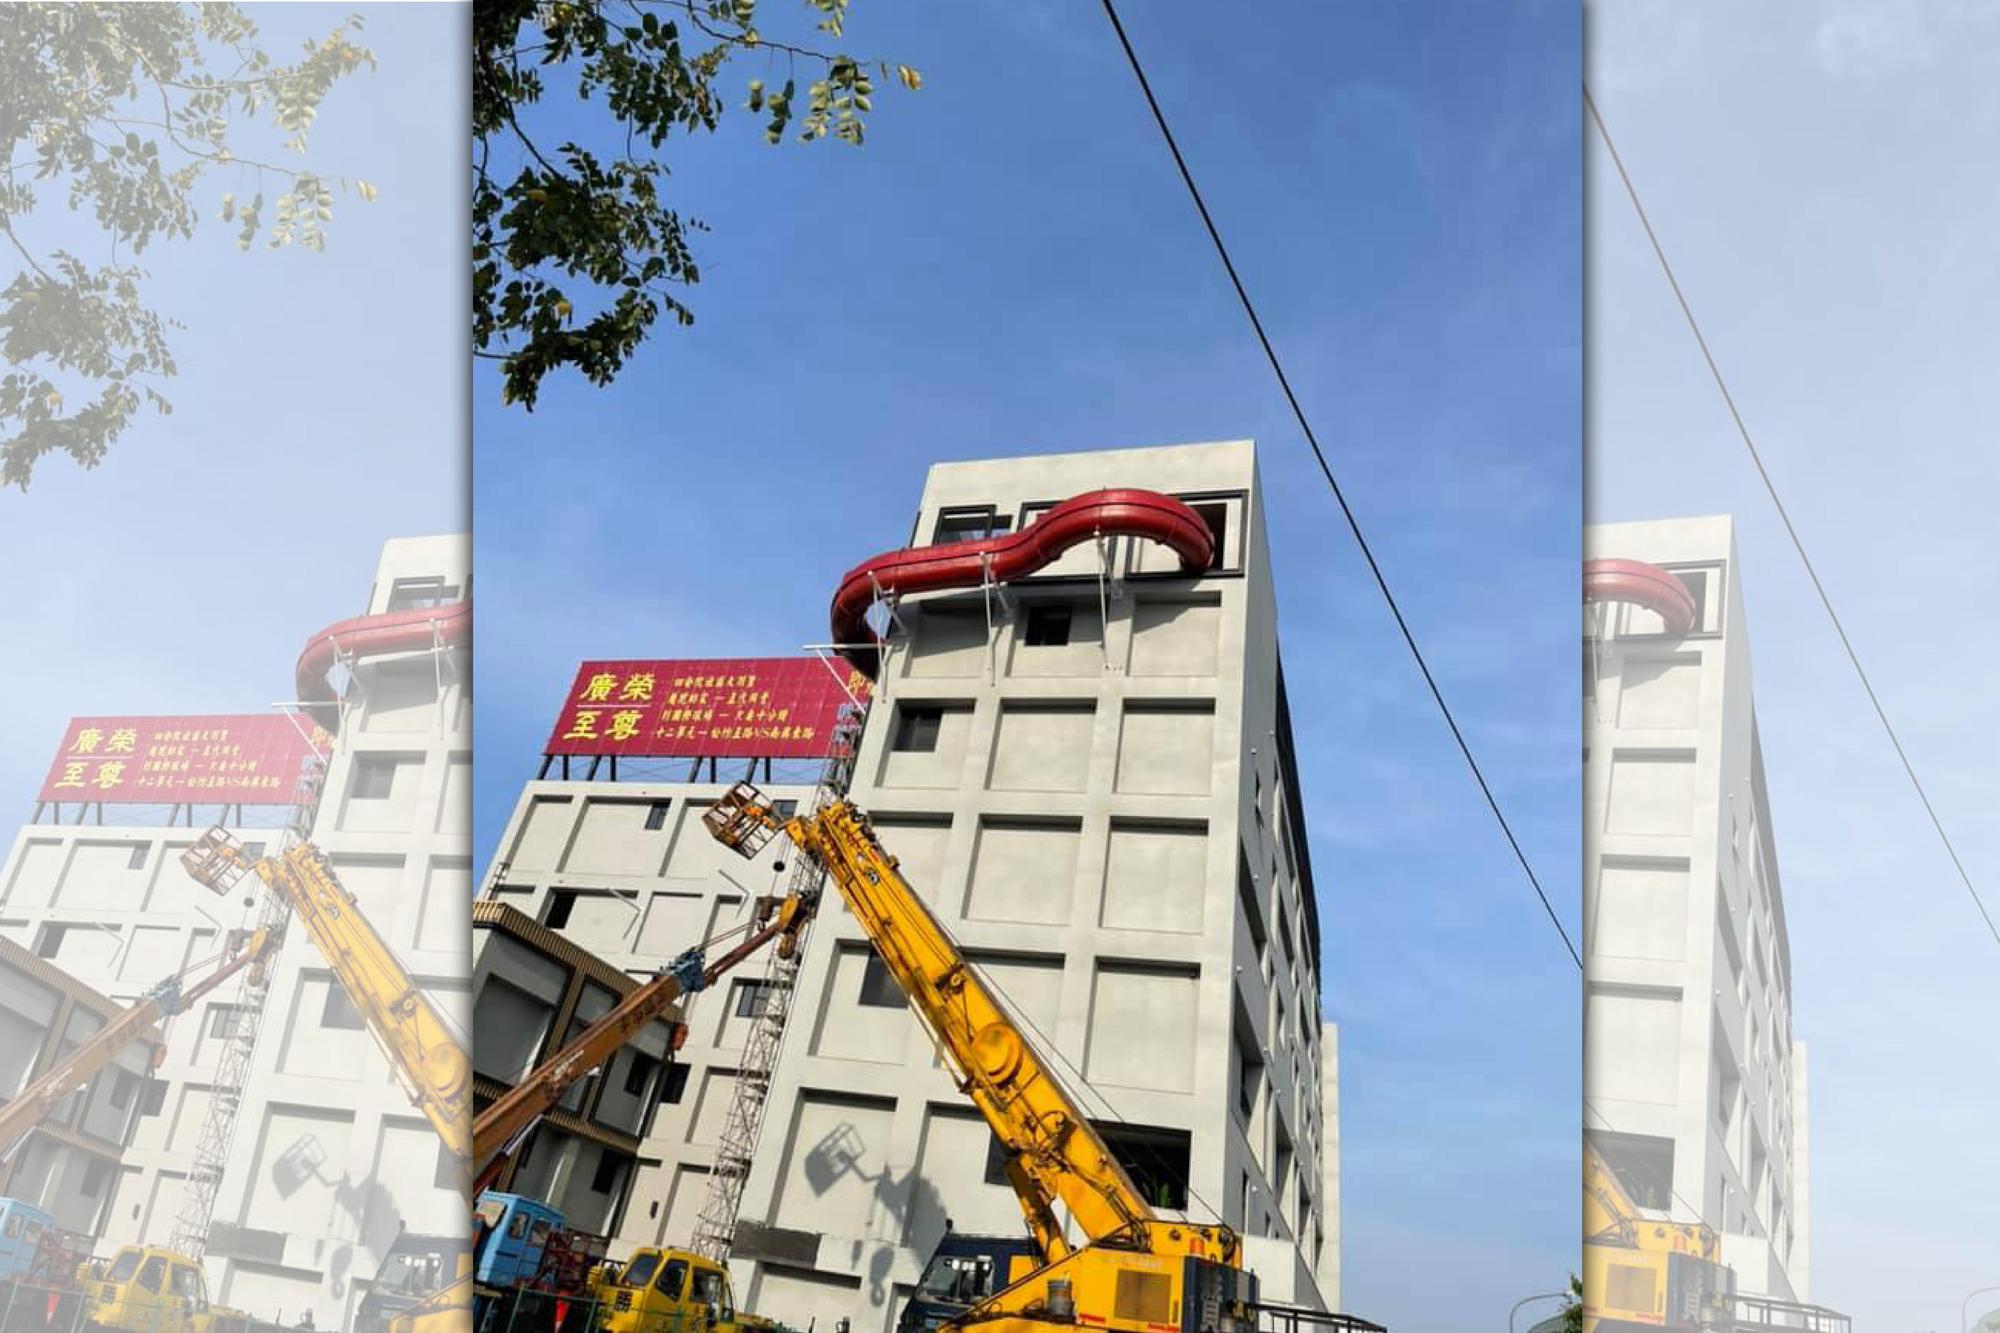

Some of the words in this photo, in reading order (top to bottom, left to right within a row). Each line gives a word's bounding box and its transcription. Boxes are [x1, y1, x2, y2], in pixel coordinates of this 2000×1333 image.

[579, 673, 656, 701] 廣榮
[563, 710, 643, 740] 至尊
[68, 727, 139, 755] 廣榮
[53, 760, 128, 790] 至尊
